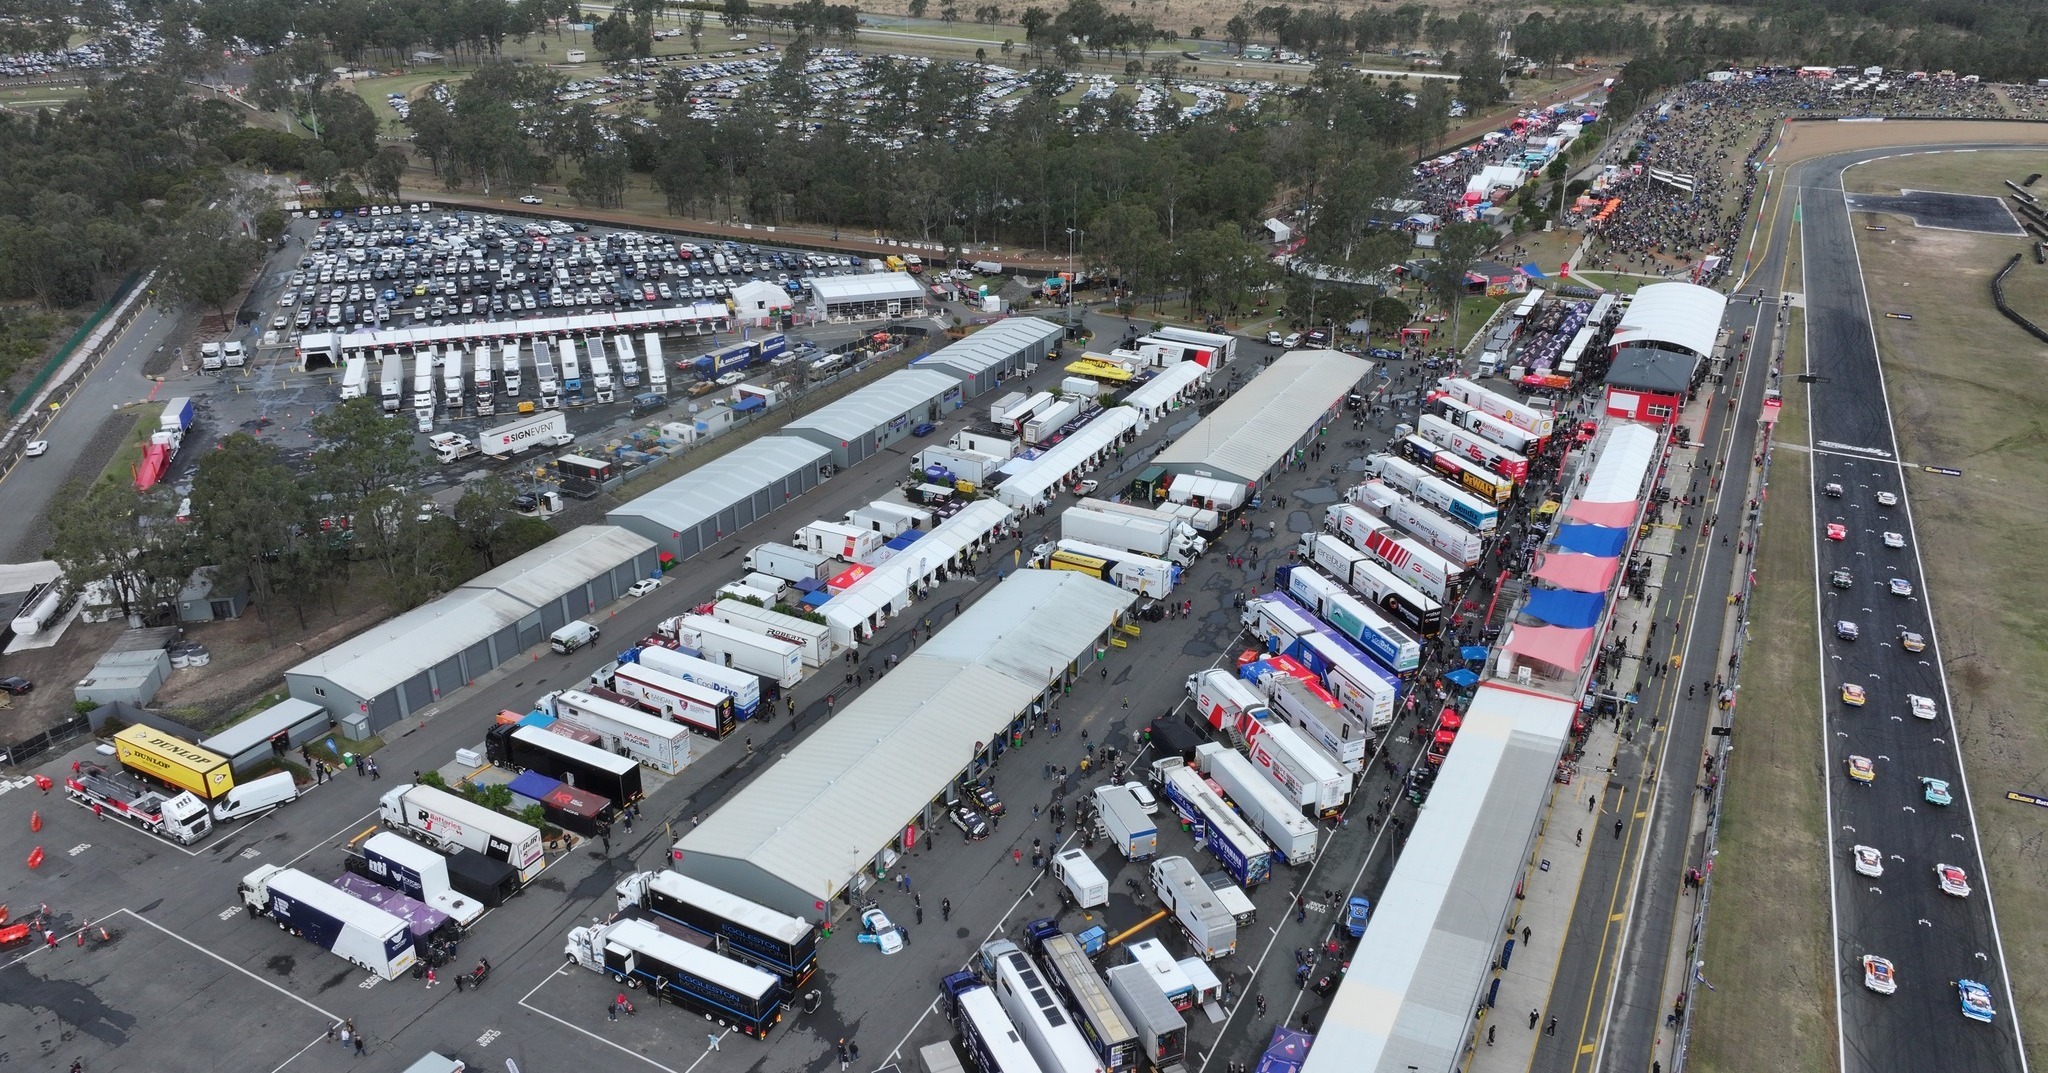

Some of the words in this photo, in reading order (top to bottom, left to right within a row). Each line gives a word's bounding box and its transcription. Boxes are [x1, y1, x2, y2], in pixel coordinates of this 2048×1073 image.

[510, 422, 554, 442] SIGNEVENT
[1482, 422, 1504, 436] Batteries
[1454, 438, 1462, 448] 12
[1454, 501, 1478, 520] Bendix
[1318, 548, 1347, 573] erebus
[766, 628, 808, 645] ROBERTS
[696, 678, 738, 697] CoolDrive
[134, 750, 170, 770] DUNLOP
[148, 738, 212, 764] DUNLOP
[176, 796, 192, 808] nti
[430, 814, 462, 830] Batteries
[490, 840, 510, 852] BJR
[1224, 842, 1242, 868] YAMAHA
[368, 858, 387, 876] nti
[722, 924, 780, 952] EGGLESTON
[678, 972, 740, 1002] EGGLESTON
[680, 978, 750, 1010] MOTORSPORT
[476, 1030, 494, 1042] LANE
[480, 1030, 502, 1048] CLEAR
